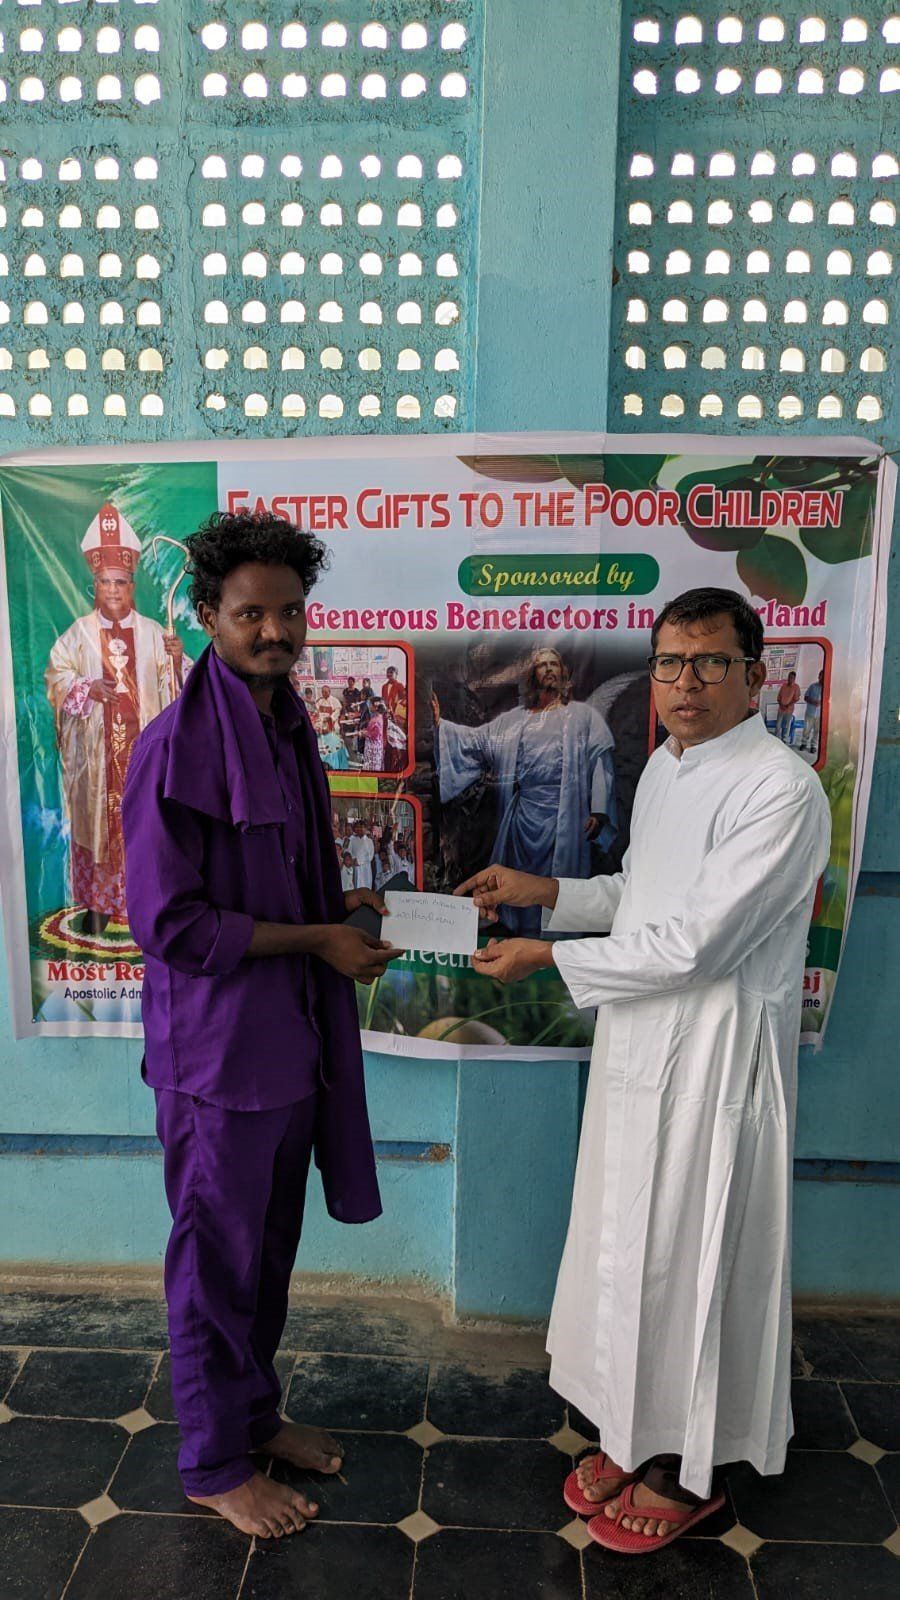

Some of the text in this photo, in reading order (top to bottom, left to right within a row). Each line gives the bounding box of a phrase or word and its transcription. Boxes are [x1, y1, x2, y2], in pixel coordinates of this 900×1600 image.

[356, 488, 451, 529] GIFTS
[458, 492, 504, 528] TO
[513, 491, 576, 527] THE
[583, 484, 681, 527] POOR
[686, 484, 844, 528] CHILDREN
[477, 562, 635, 593] Sponsored by
[306, 598, 828, 630] Generous Benefactors in rland
[47, 961, 107, 981] Most
[114, 961, 146, 981] Re
[64, 986, 117, 1001] Apostolic
